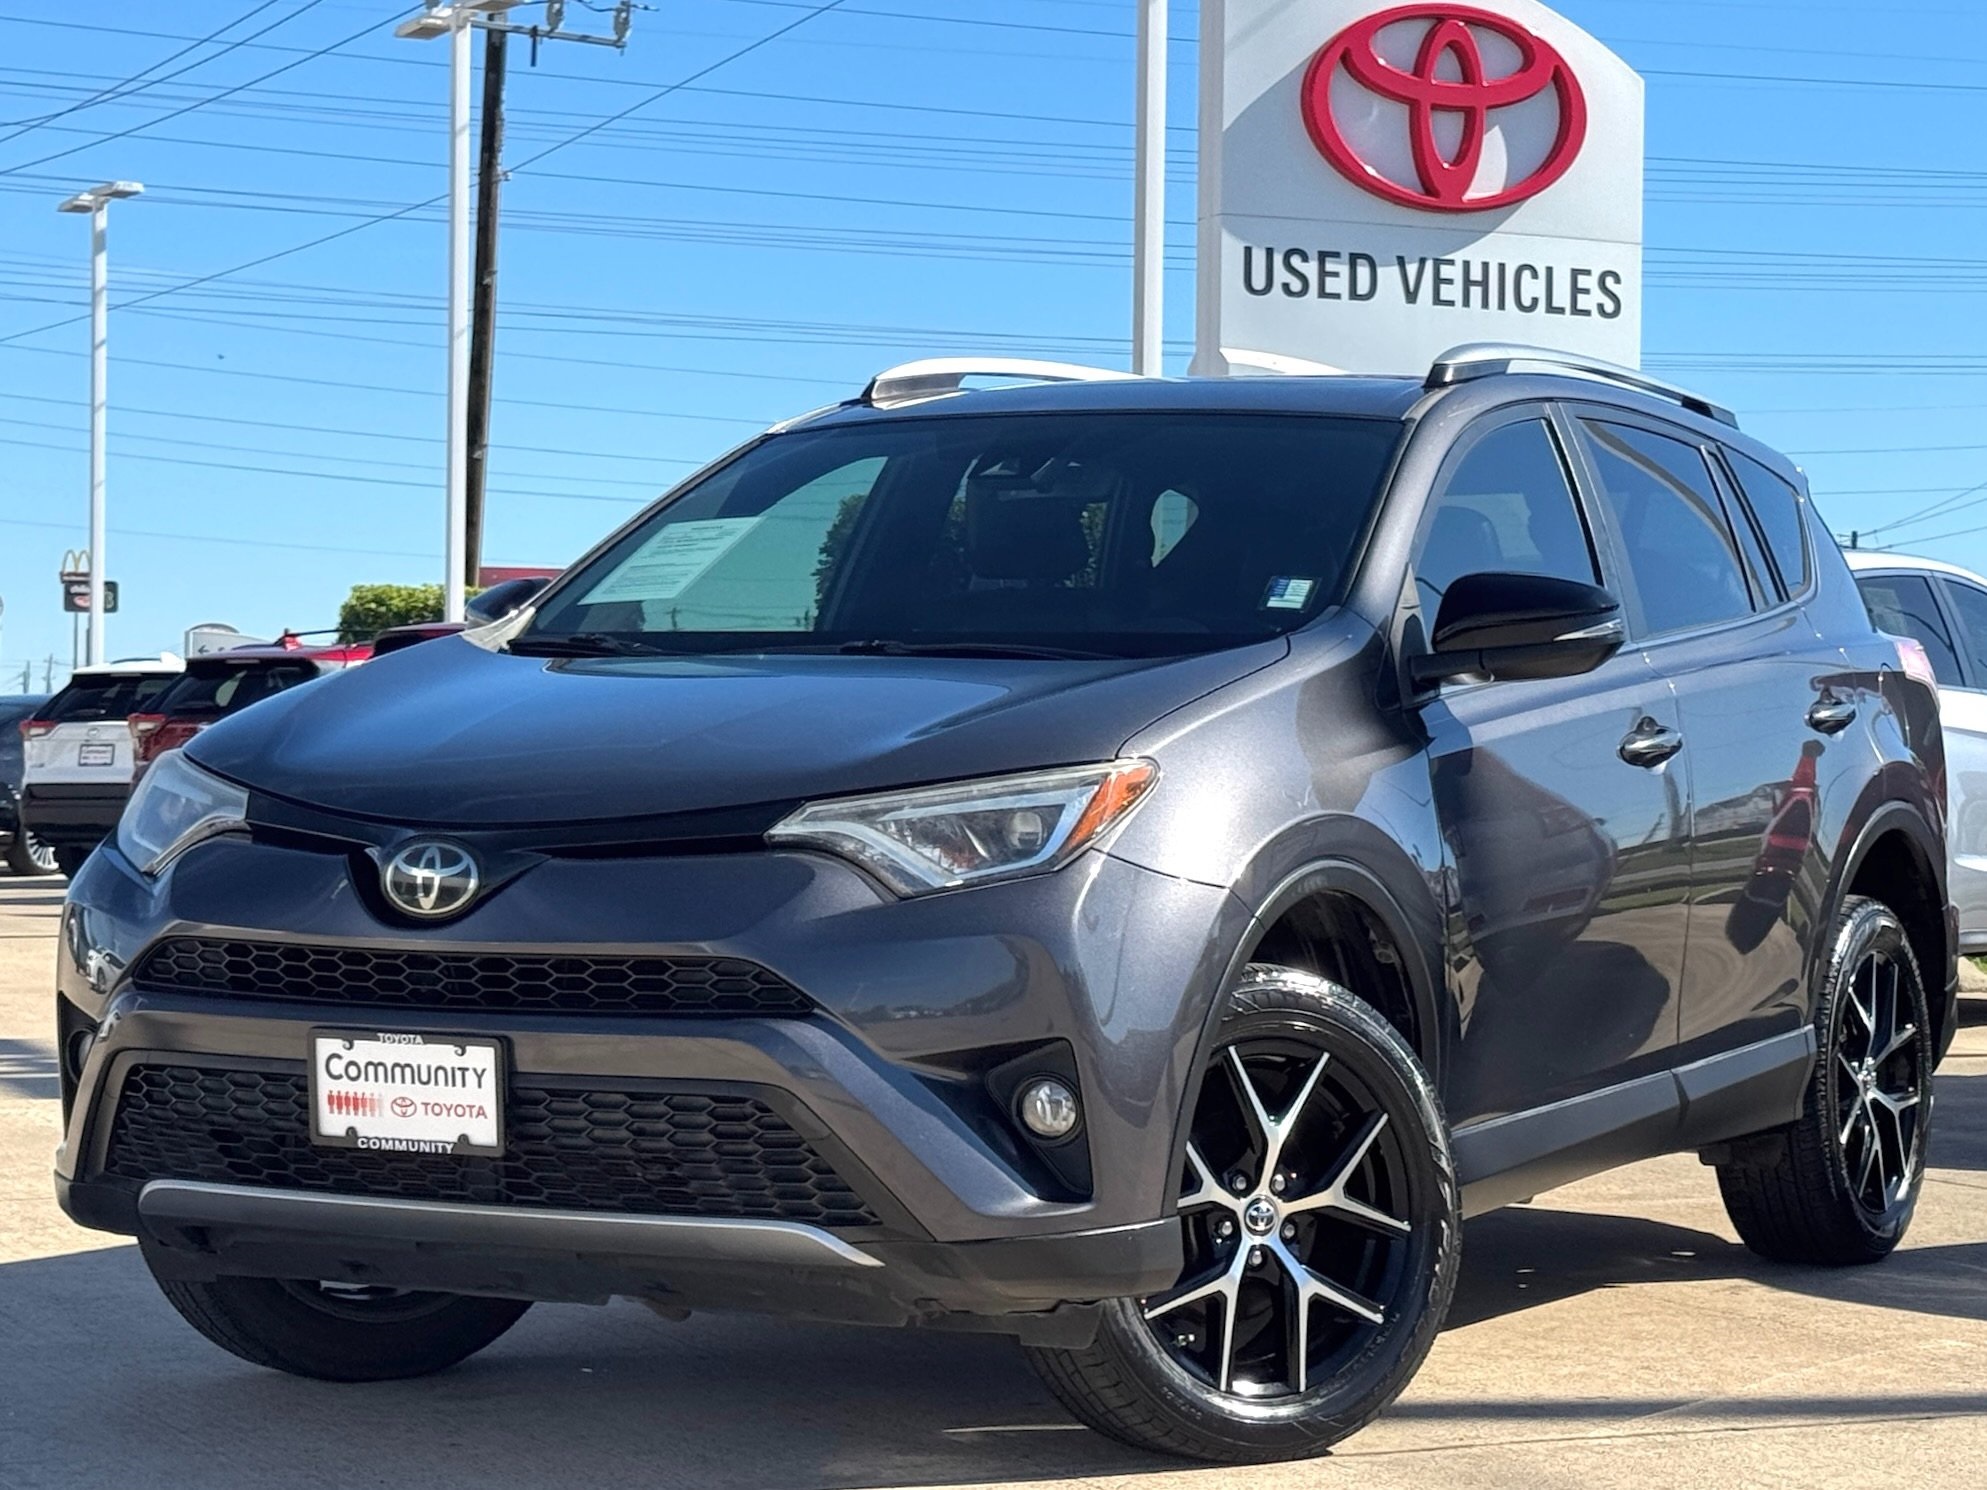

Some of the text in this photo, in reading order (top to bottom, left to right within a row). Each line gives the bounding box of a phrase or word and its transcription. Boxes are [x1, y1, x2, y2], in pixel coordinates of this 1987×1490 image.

[1242, 246, 1623, 320] USED VEHICLES
[376, 1033, 424, 1045] TOYOTA
[421, 1102, 488, 1119] TOYOTA
[357, 1137, 455, 1154] COMMUNITY
